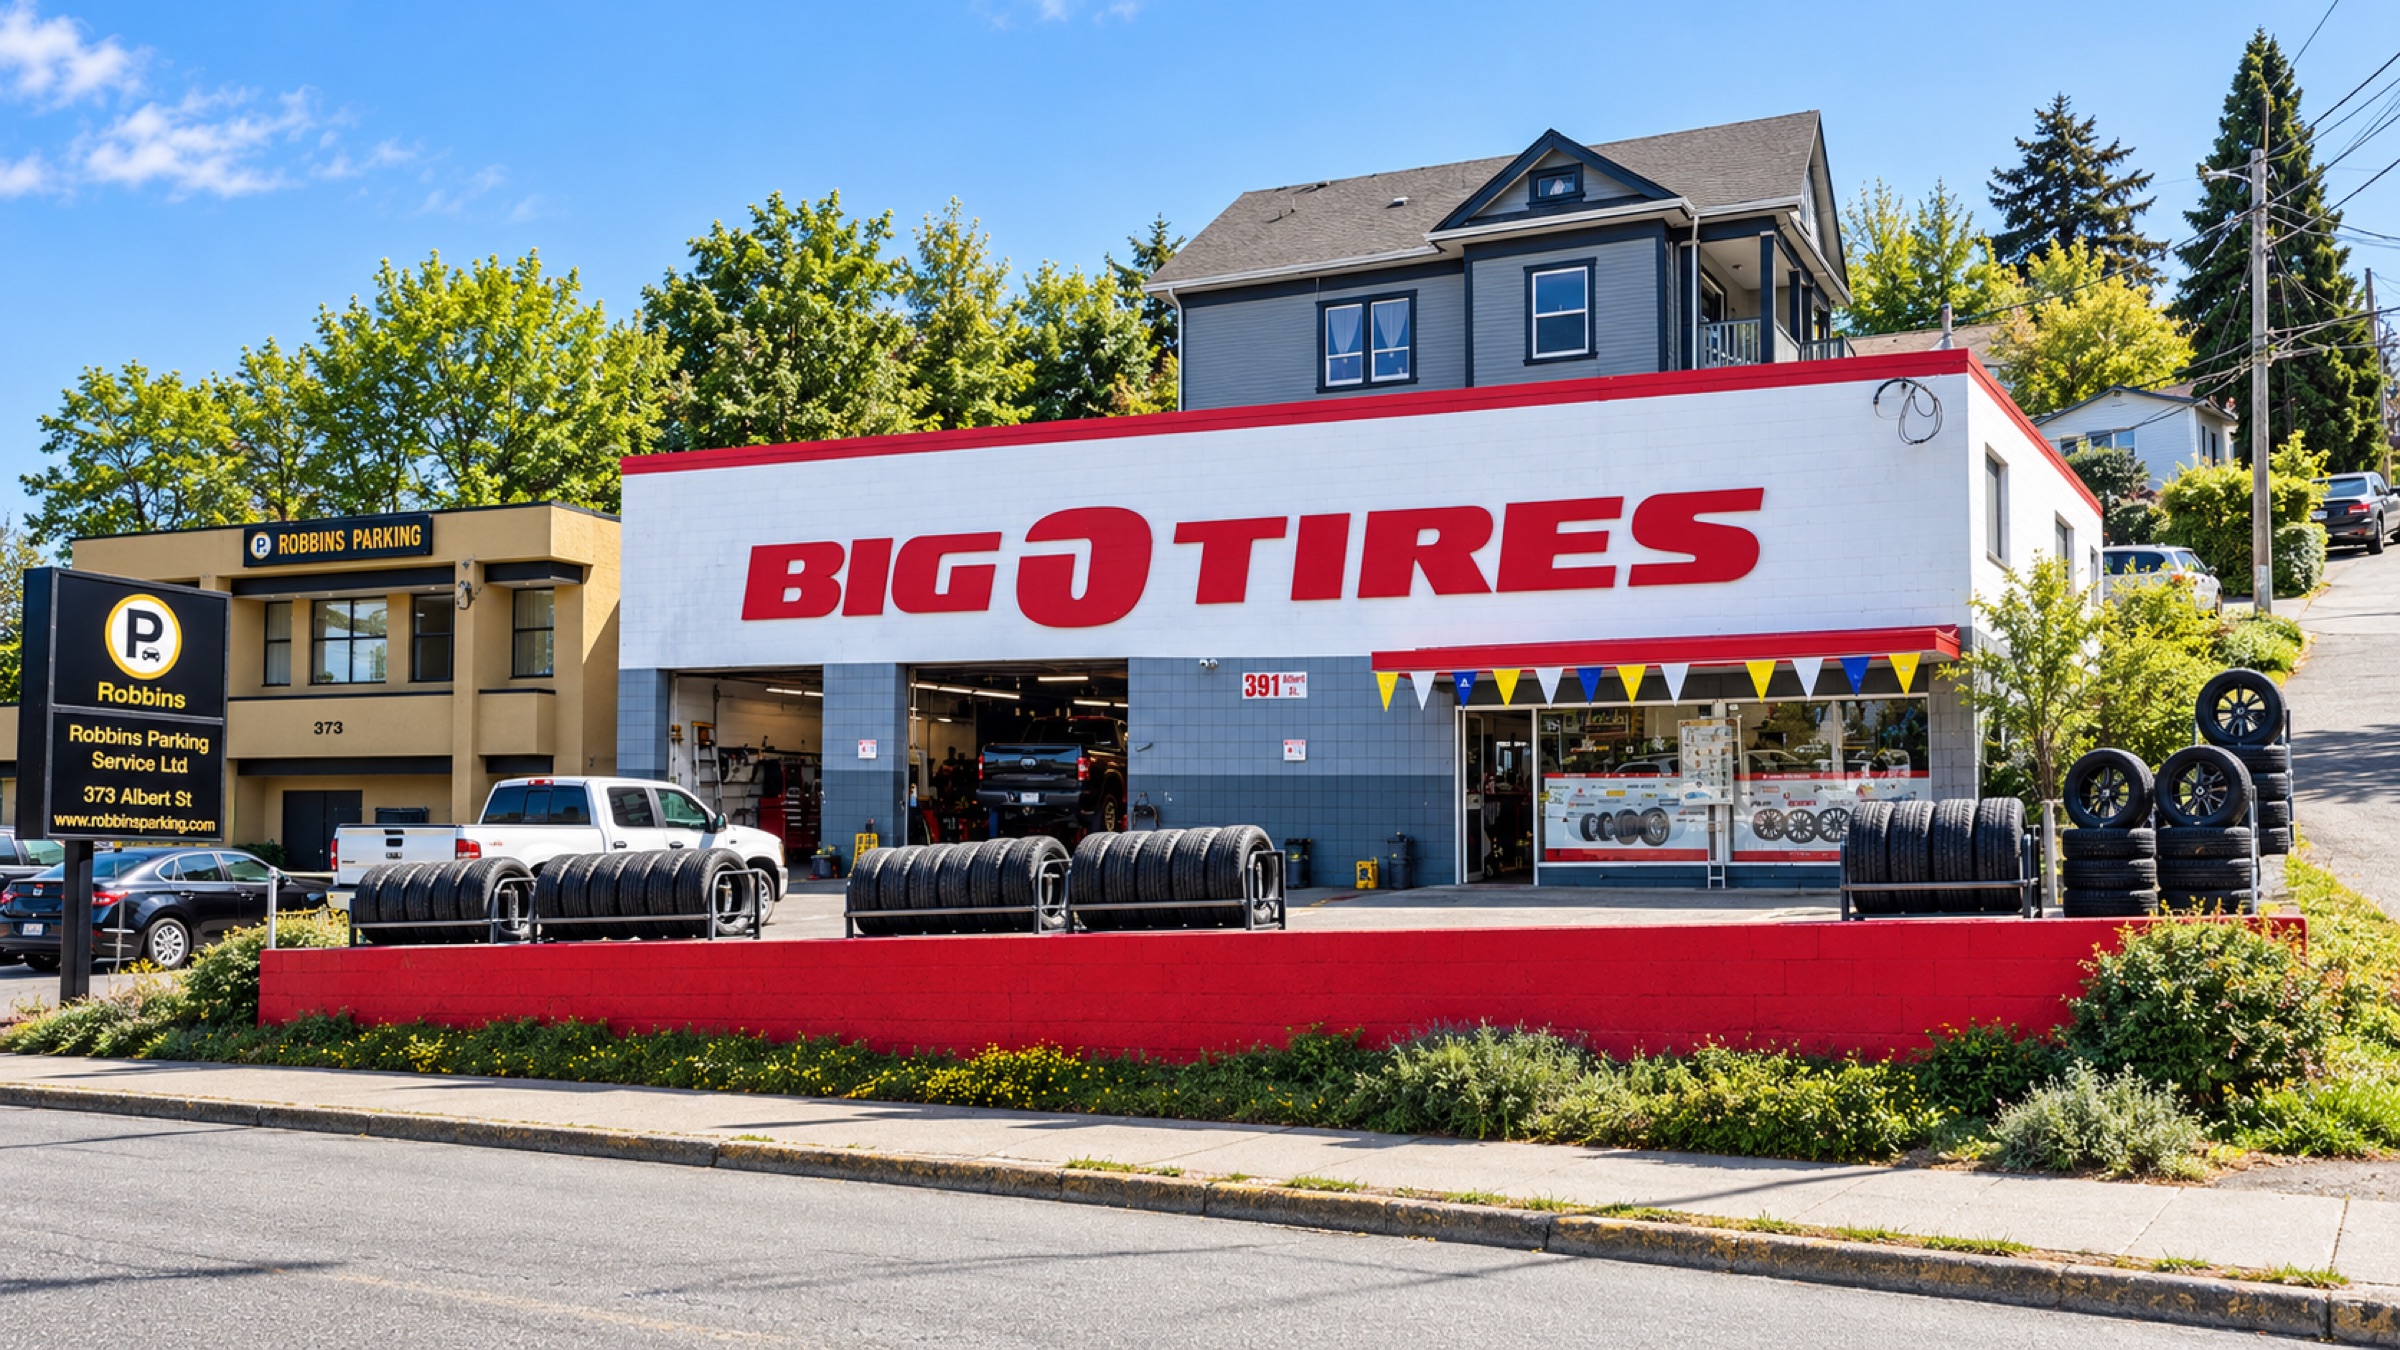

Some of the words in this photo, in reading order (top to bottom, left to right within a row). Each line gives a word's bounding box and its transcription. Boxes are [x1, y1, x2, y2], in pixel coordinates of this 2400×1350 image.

[278, 529, 346, 555] ROBBINS
[352, 524, 422, 550] PARKING
[741, 531, 1002, 621] BIG
[1016, 506, 1153, 628] O
[1173, 487, 1765, 605] TIRES
[126, 608, 163, 658] P
[97, 681, 186, 709] Robbins
[1244, 673, 1280, 697] 391
[69, 724, 142, 746] Robbins
[147, 730, 209, 755] Parking
[313, 720, 344, 736] 373
[91, 751, 156, 772] Service
[160, 756, 189, 774] Ltd
[83, 785, 116, 804] 373
[120, 787, 171, 807] Albert
[174, 790, 193, 808] St
[53, 813, 216, 835] www.robbinsparking.com
